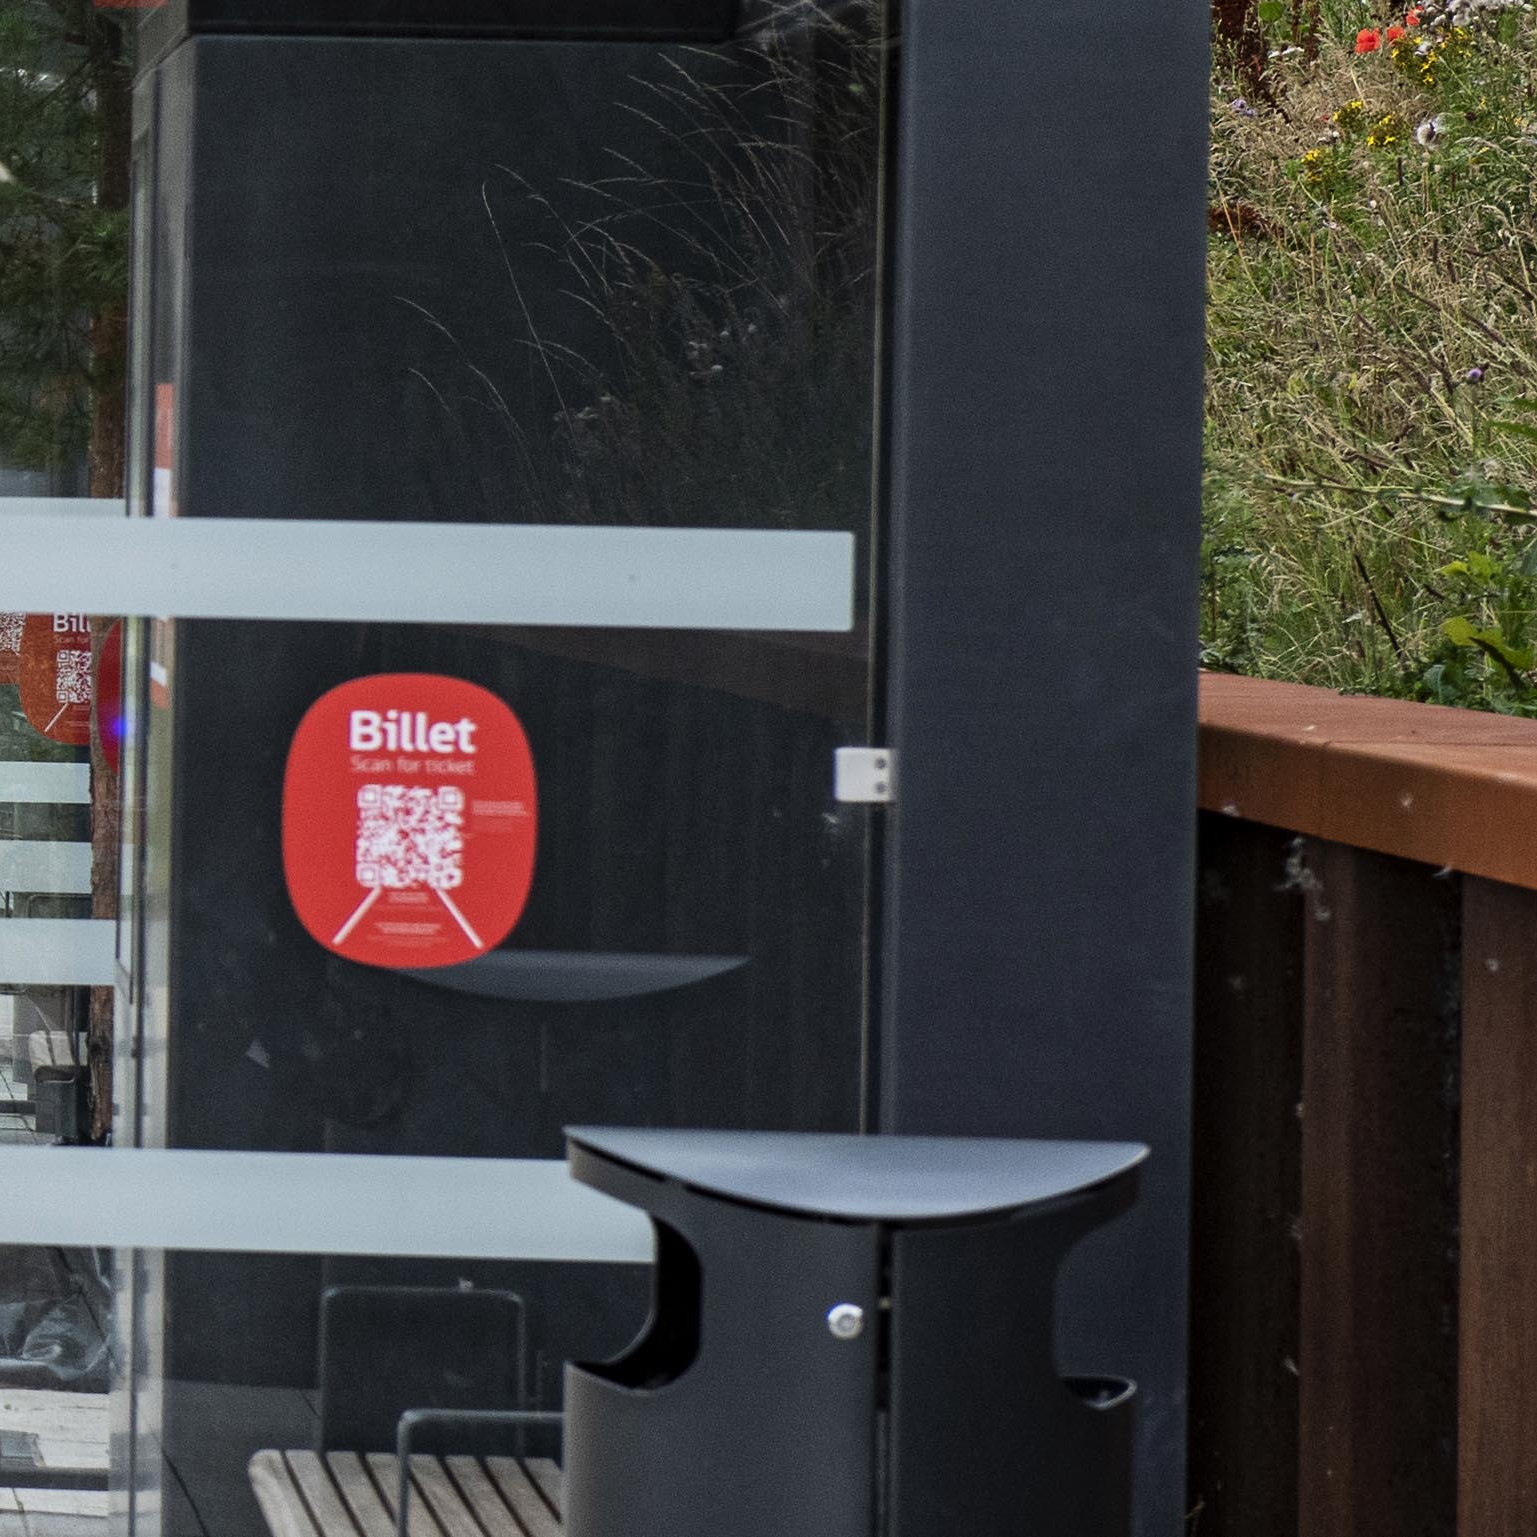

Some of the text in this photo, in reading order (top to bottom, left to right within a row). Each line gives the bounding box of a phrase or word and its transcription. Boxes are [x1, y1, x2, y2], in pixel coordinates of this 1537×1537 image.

[349, 709, 477, 754] Billet
[351, 755, 475, 775] Scan for ticket
